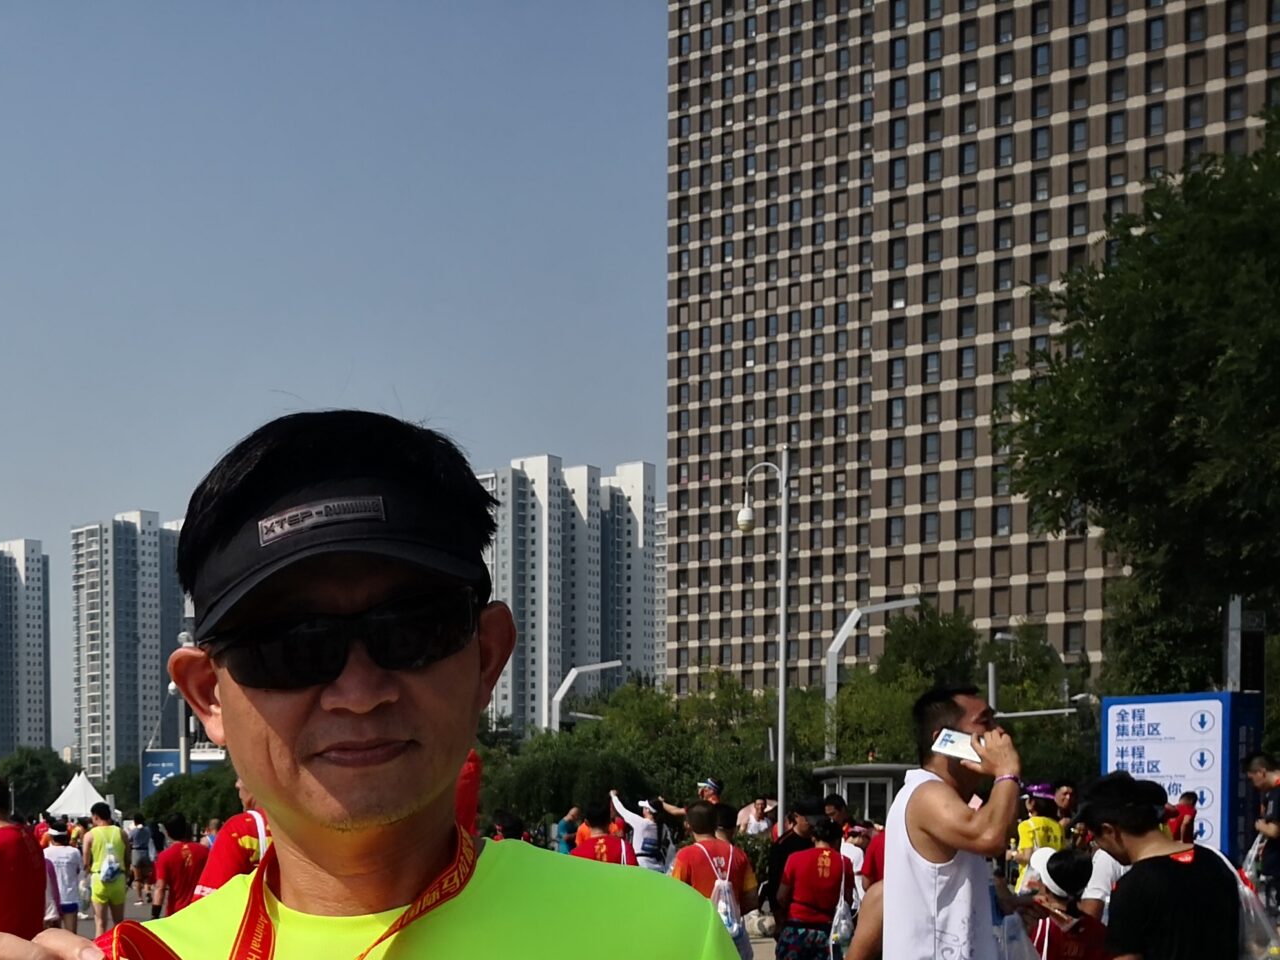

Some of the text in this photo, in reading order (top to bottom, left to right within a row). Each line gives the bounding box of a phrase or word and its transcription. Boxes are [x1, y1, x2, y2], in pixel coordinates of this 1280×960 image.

[1116, 708, 1146, 723] 全程
[1116, 722, 1161, 737] 集结区
[1115, 745, 1145, 760] 半程
[251, 914, 269, 953] Animal
